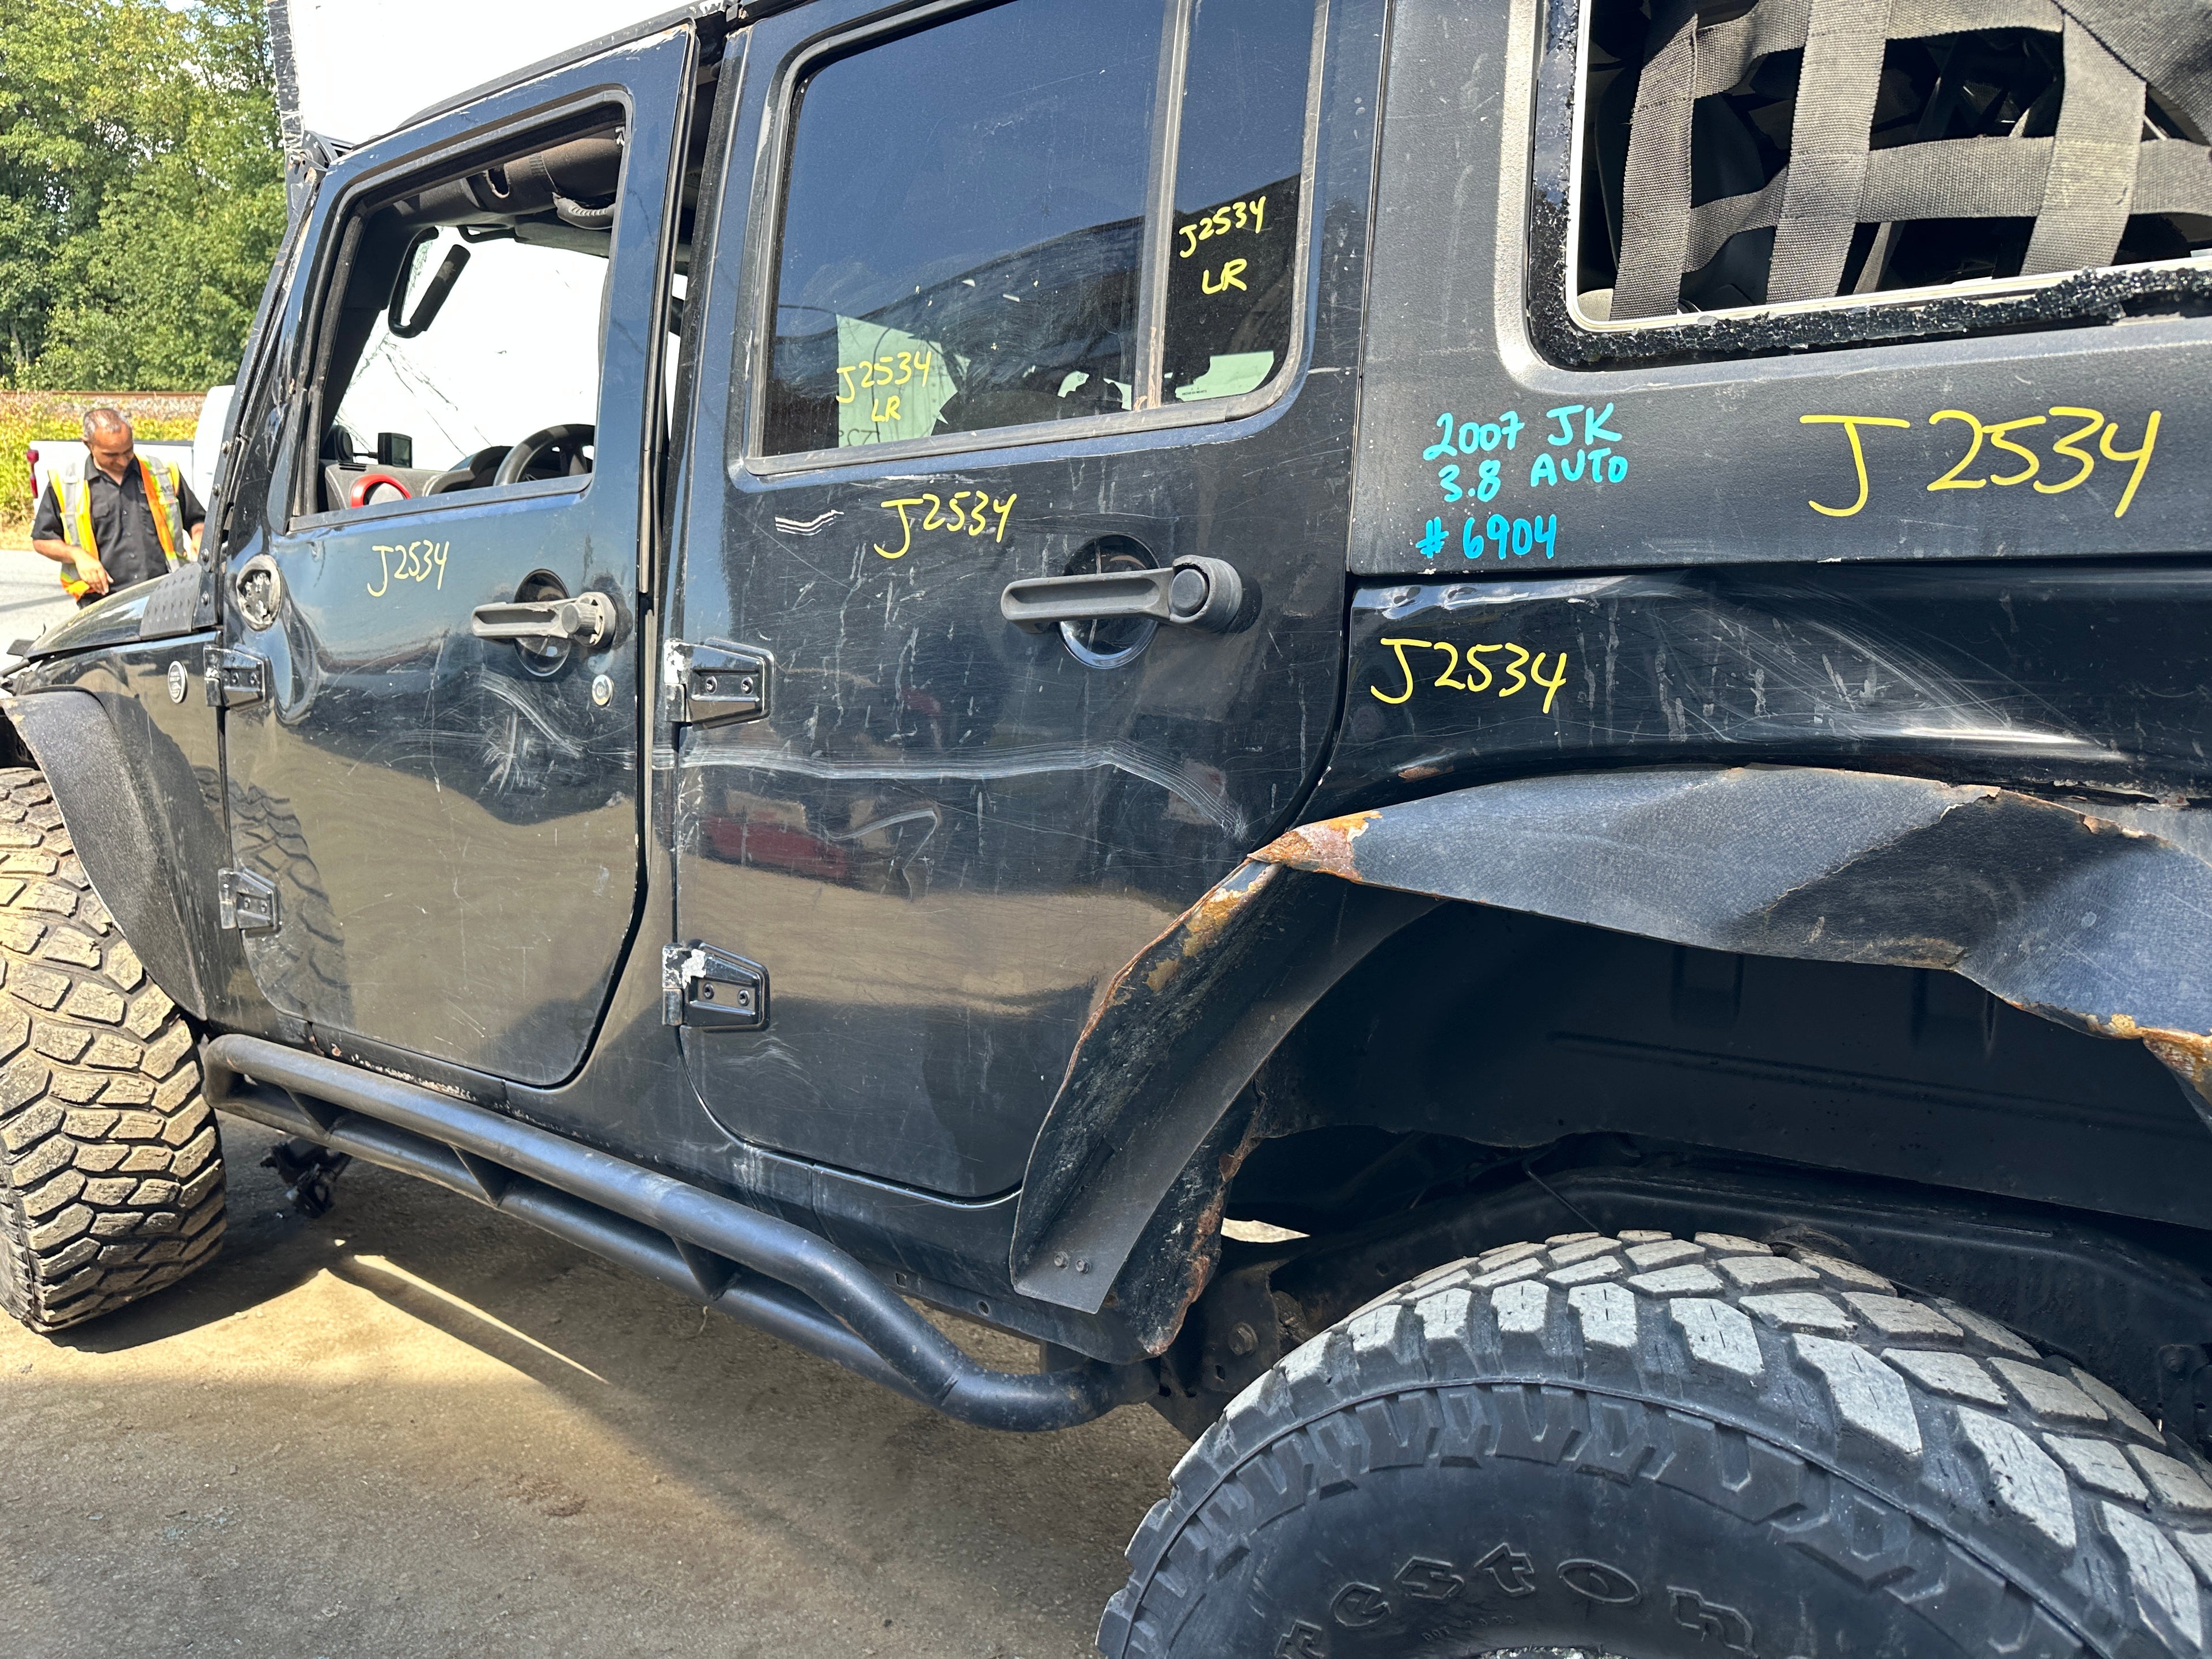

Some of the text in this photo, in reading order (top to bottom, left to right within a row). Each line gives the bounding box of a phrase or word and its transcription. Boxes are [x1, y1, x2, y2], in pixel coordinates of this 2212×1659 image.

[1180, 197, 1266, 258] J2534
[1202, 258, 1247, 294] LR
[836, 351, 932, 403] J2534
[871, 395, 902, 422] LR
[1423, 402, 1622, 461] 2007 JK
[1438, 447, 1628, 502] 3.8 AUTO
[874, 491, 1017, 559] J2534
[367, 539, 450, 597] J2534
[1370, 638, 1567, 713] J2534
